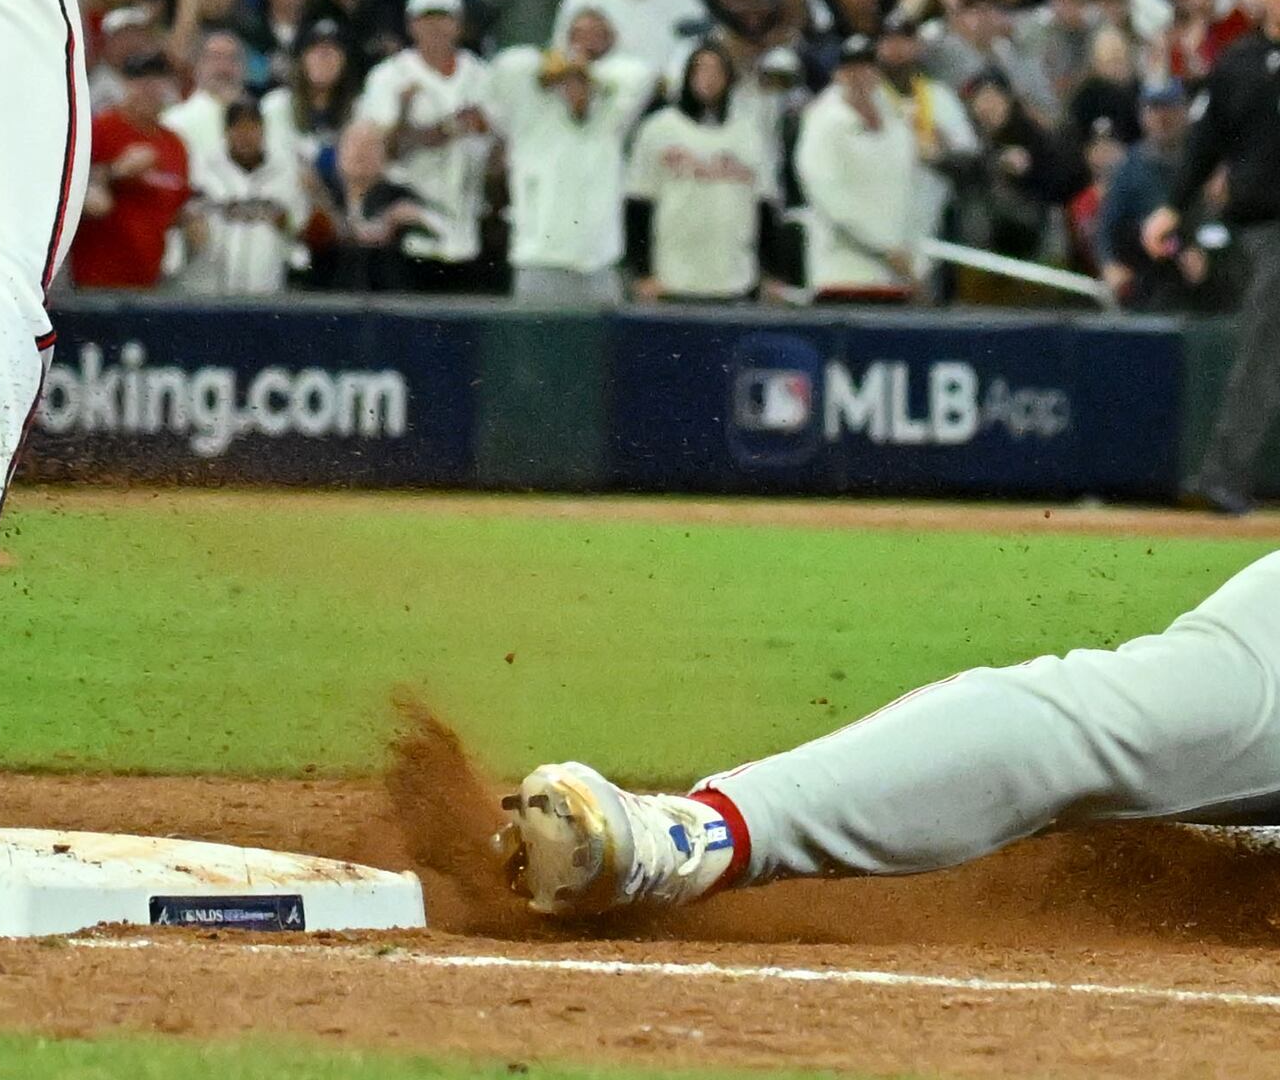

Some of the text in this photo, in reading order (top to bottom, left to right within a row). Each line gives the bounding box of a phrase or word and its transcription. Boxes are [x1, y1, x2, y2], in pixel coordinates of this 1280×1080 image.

[31, 341, 408, 457] oking.com
[824, 360, 978, 445] MLB
[195, 909, 223, 922] NLDS
